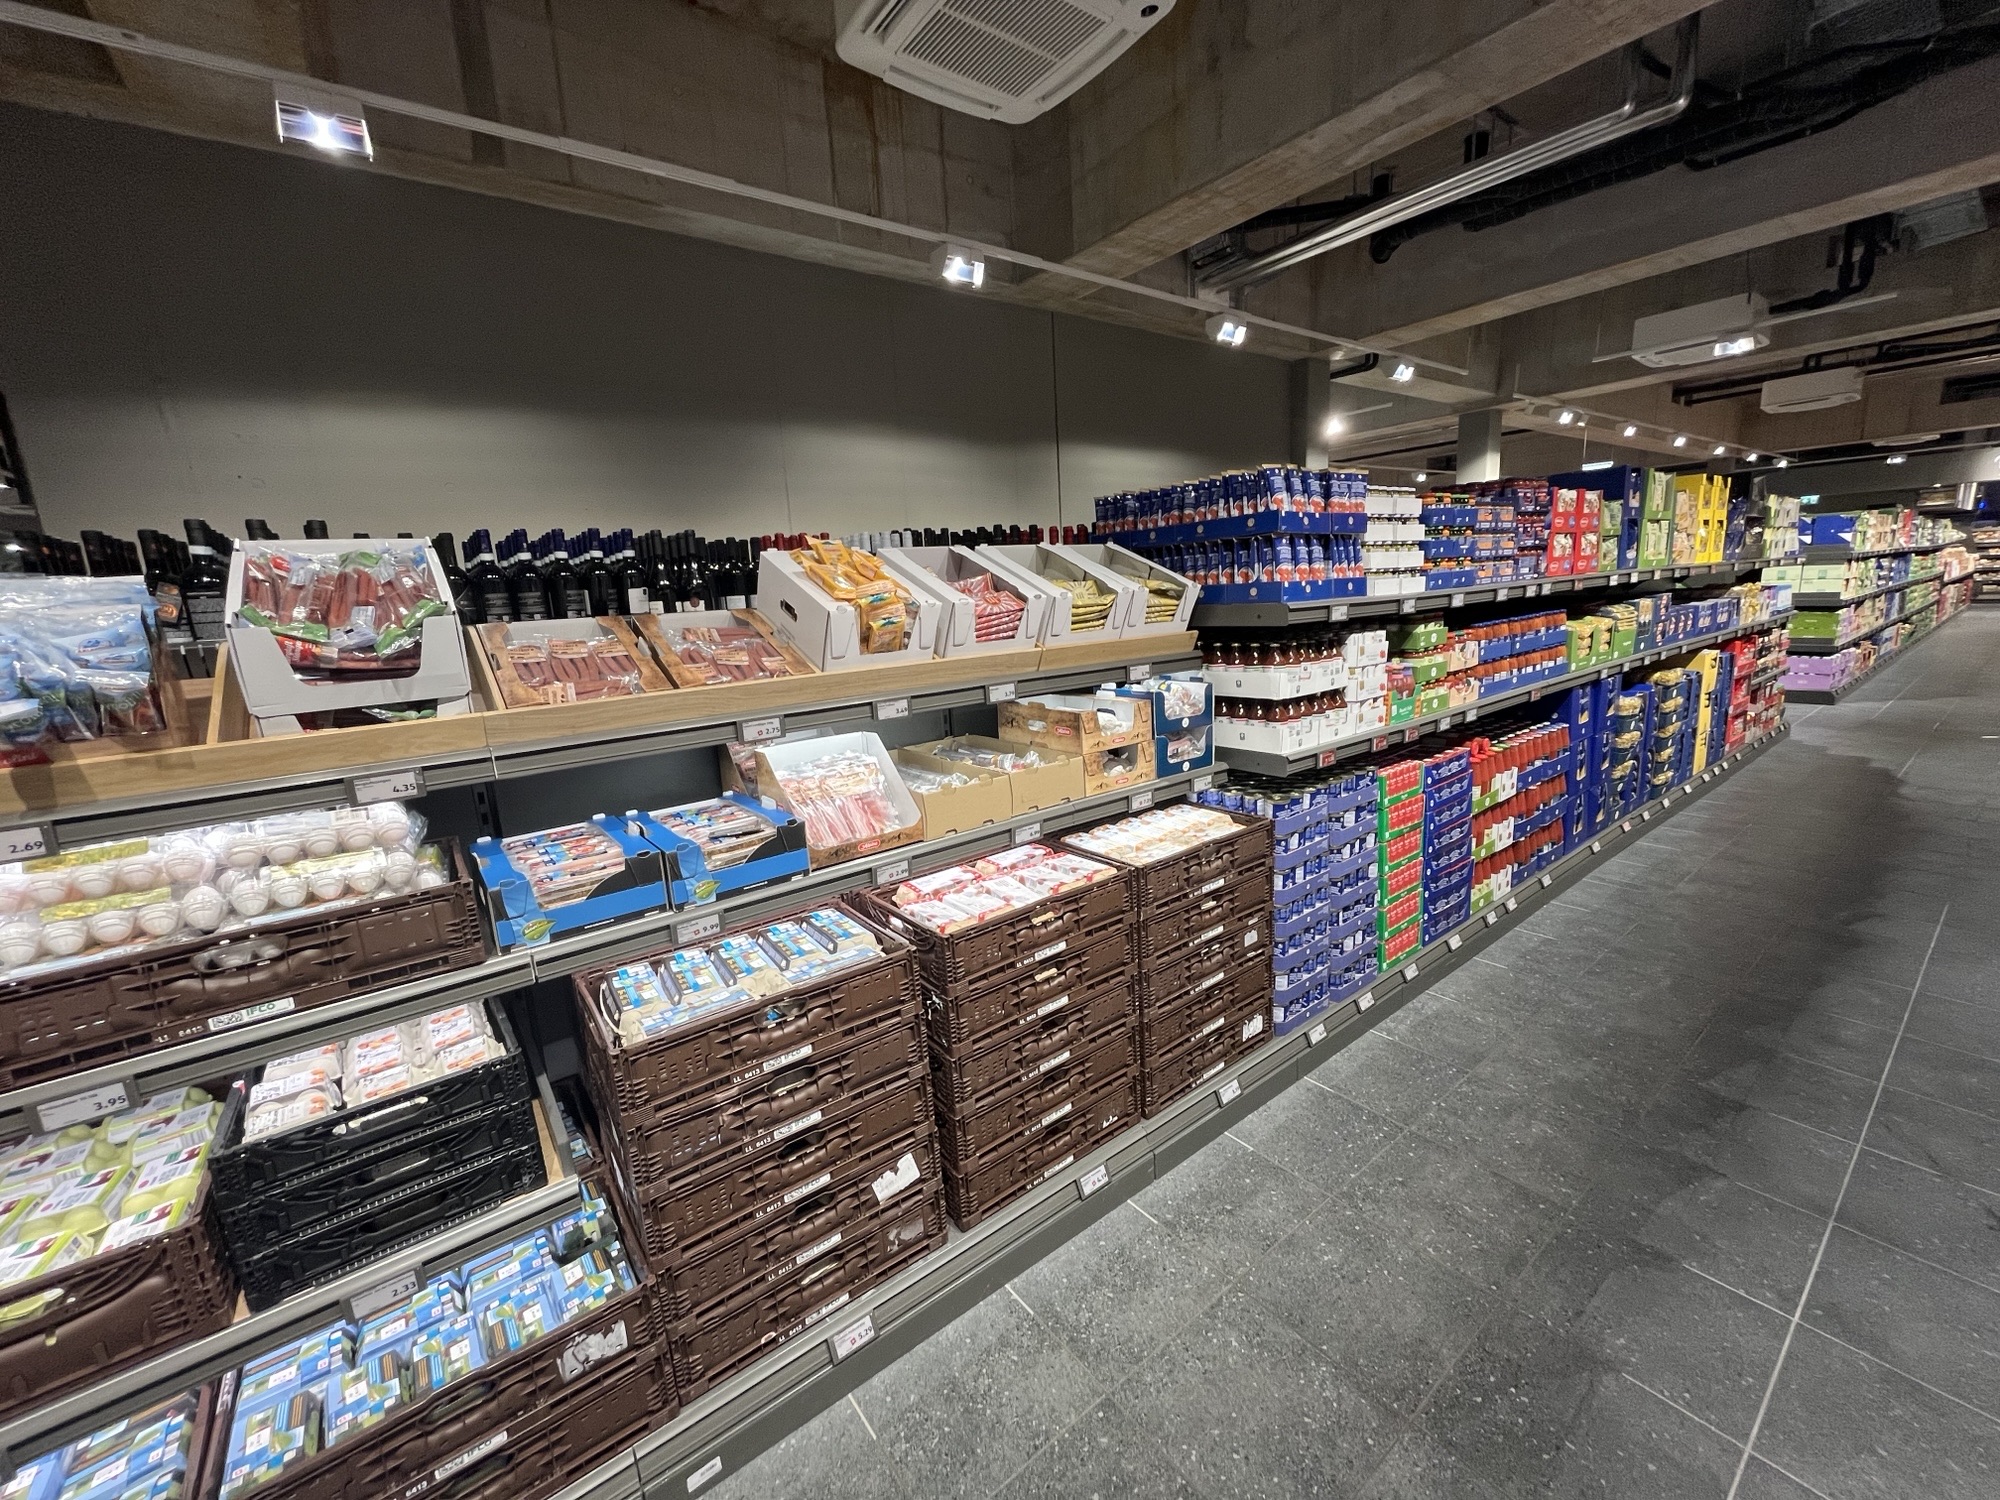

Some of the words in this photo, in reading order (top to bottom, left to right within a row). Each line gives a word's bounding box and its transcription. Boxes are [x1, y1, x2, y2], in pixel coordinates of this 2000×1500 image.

[895, 706, 908, 714] 3.49
[765, 727, 781, 735] 2.75
[392, 783, 416, 793] 4.35
[8, 841, 43, 854] 2.69
[895, 868, 908, 876] 2.99
[702, 923, 719, 932] 9.99
[246, 1003, 276, 1017] IFCO
[784, 1048, 802, 1060] IFCO
[744, 1069, 760, 1079] 6413
[94, 1095, 126, 1111] 3.95
[794, 1115, 811, 1128] IFCO
[745, 1145, 754, 1153] LL
[756, 1137, 772, 1147] 6413
[756, 1210, 764, 1218] LL
[766, 1201, 782, 1212] 6413
[768, 1273, 776, 1281] LL
[778, 1263, 793, 1275] 6413
[392, 1281, 416, 1297] 2.33
[779, 1334, 787, 1343] LL
[789, 1324, 803, 1335] 6413
[858, 1326, 873, 1339] 5.29
[405, 1480, 428, 1498] 6413
